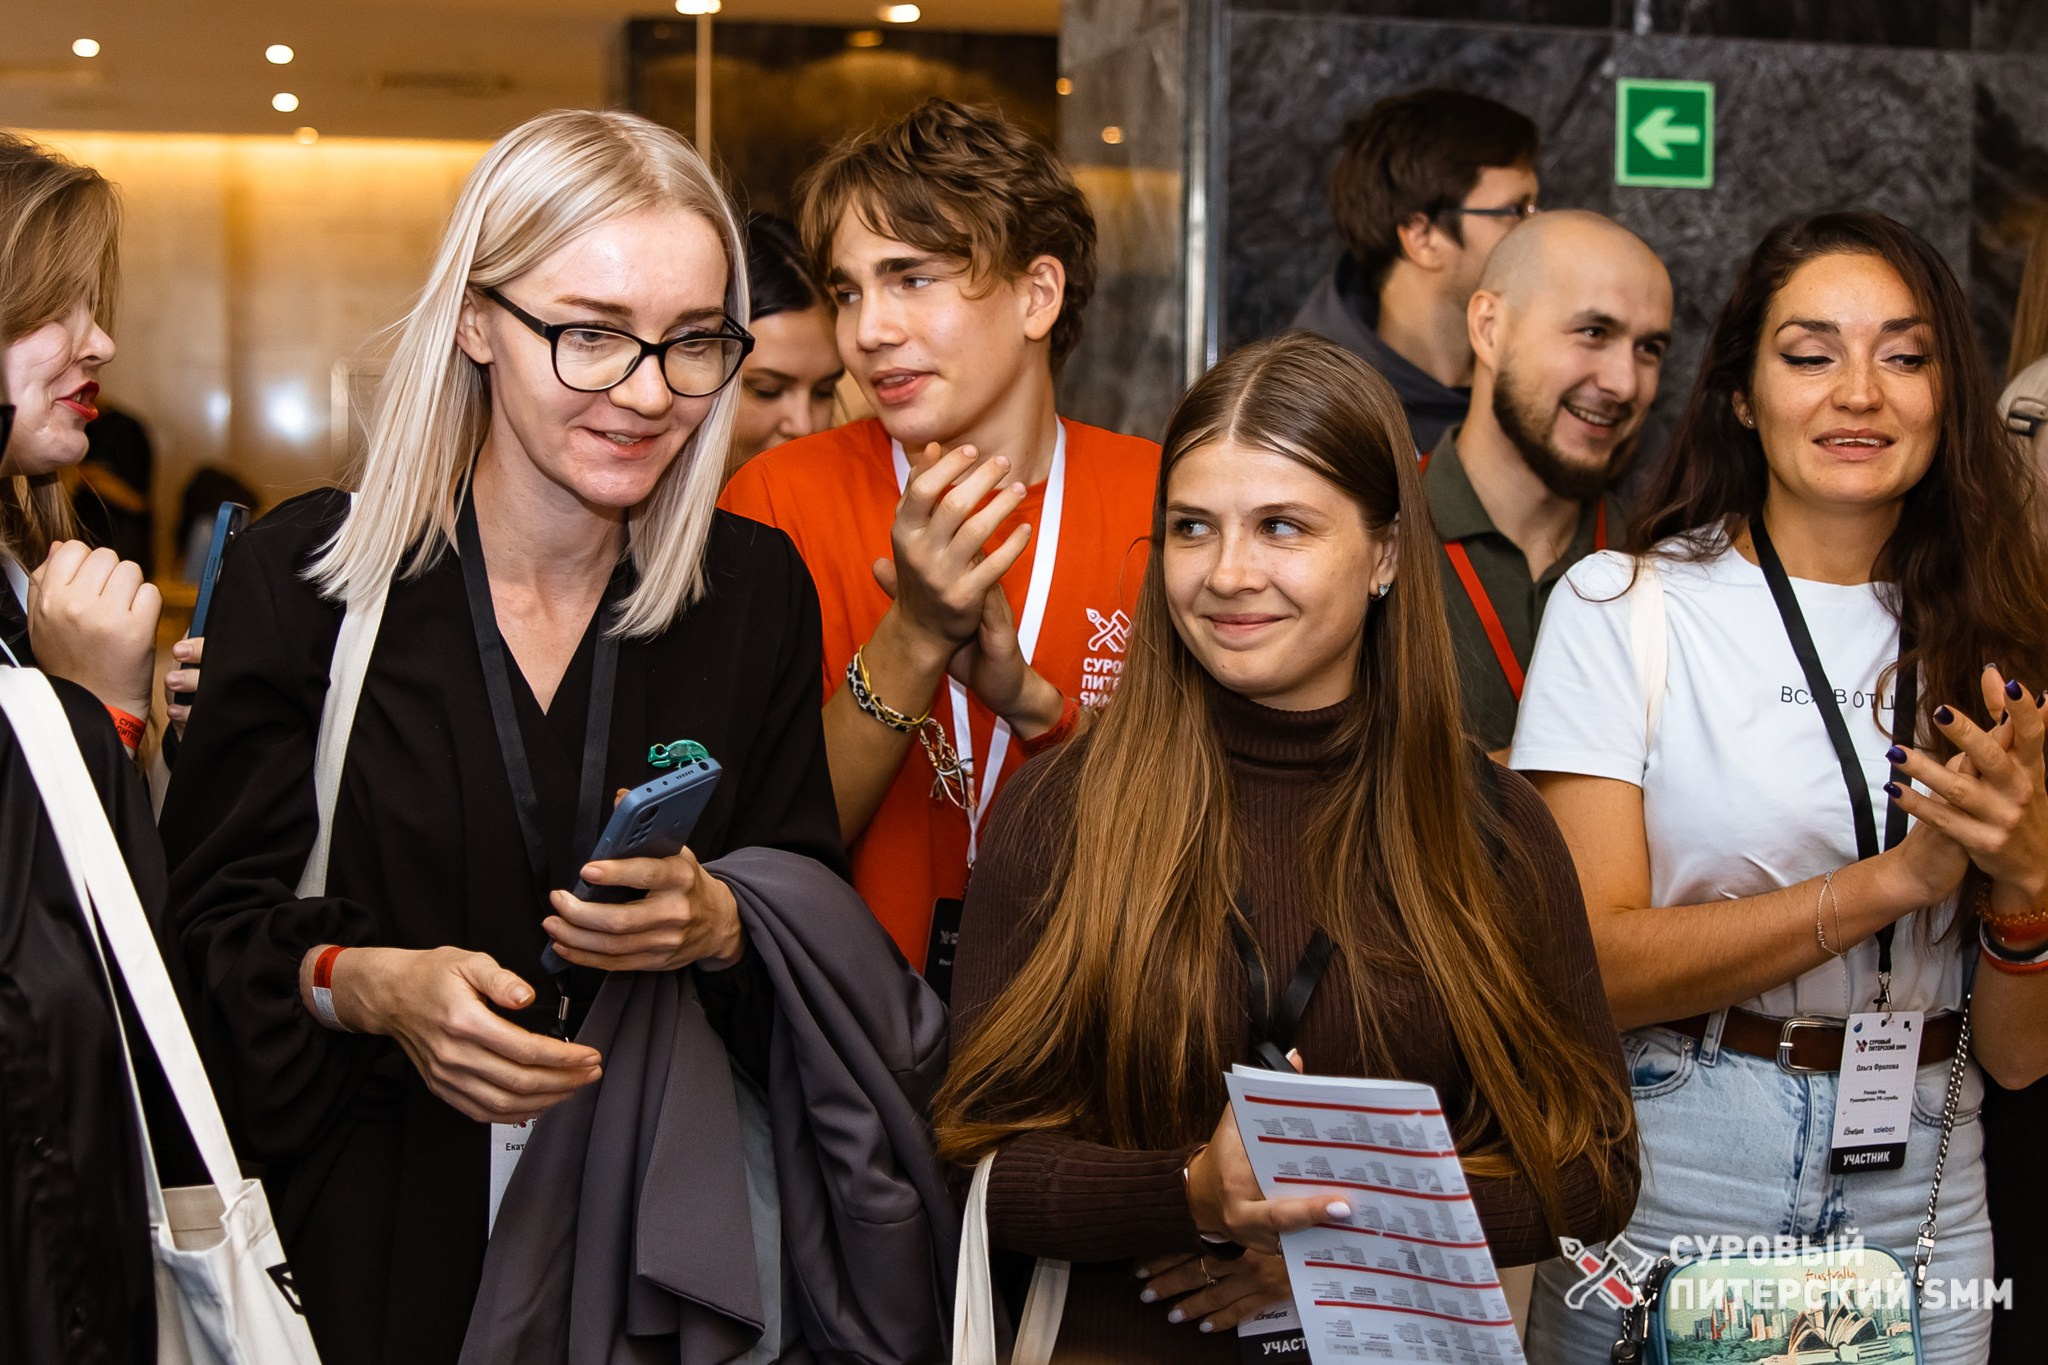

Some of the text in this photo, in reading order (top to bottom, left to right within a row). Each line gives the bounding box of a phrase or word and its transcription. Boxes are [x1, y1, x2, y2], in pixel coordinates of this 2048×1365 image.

[1083, 657, 1125, 674] СУРО
[1874, 1063, 1899, 1072] Фролова
[1843, 1151, 1890, 1165] УЧАСТНИК
[1262, 1336, 1308, 1356] УЧАСТ
